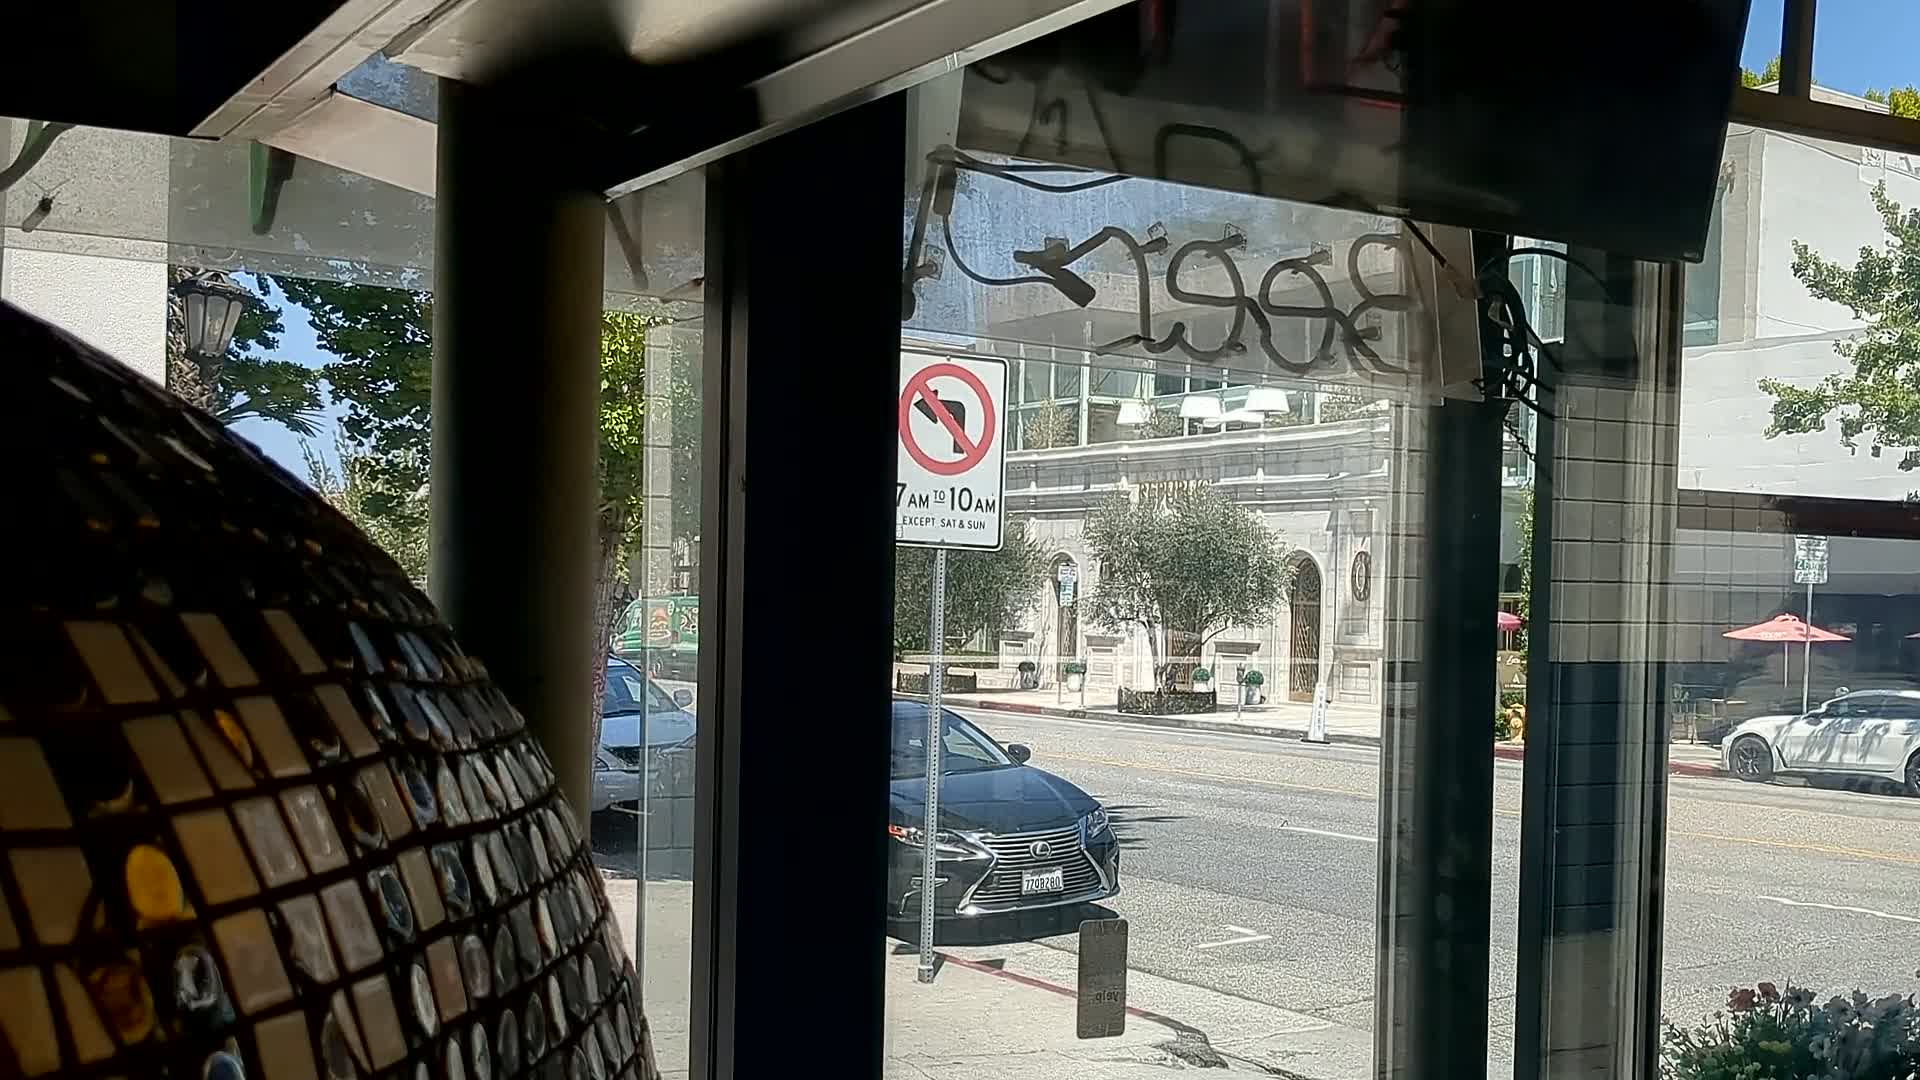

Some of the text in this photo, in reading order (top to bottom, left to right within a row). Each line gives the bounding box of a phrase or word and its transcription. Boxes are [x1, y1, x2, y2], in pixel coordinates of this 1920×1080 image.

[933, 489, 946, 501] TO
[949, 486, 996, 514] 10AM
[902, 516, 936, 527] EXCEPT
[940, 518, 956, 529] SAT
[967, 520, 986, 530] SUN
